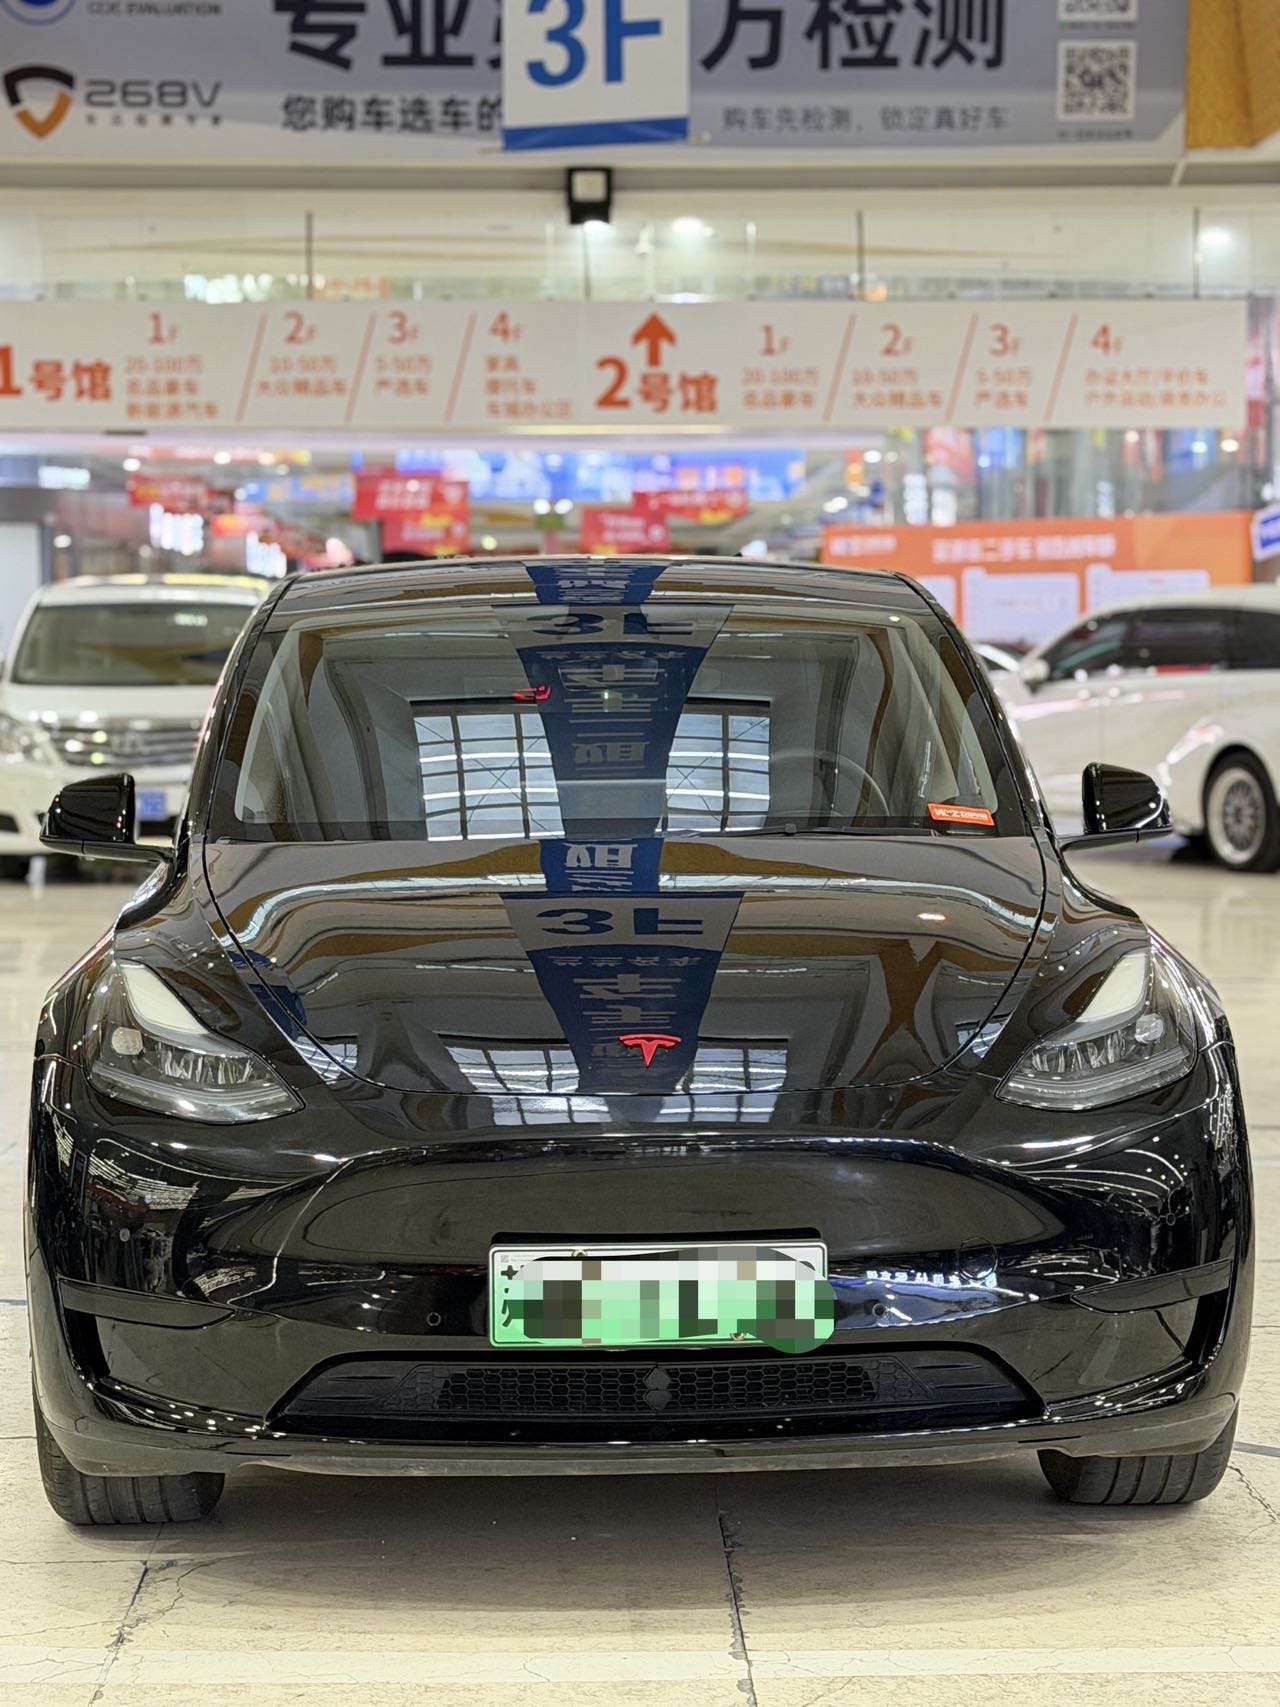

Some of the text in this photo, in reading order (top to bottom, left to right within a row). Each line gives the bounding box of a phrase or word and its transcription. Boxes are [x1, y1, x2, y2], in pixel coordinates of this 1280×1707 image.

[526, 0, 663, 88] 3F
[85, 79, 222, 108] 268V
[595, 355, 718, 412] 2号馆
